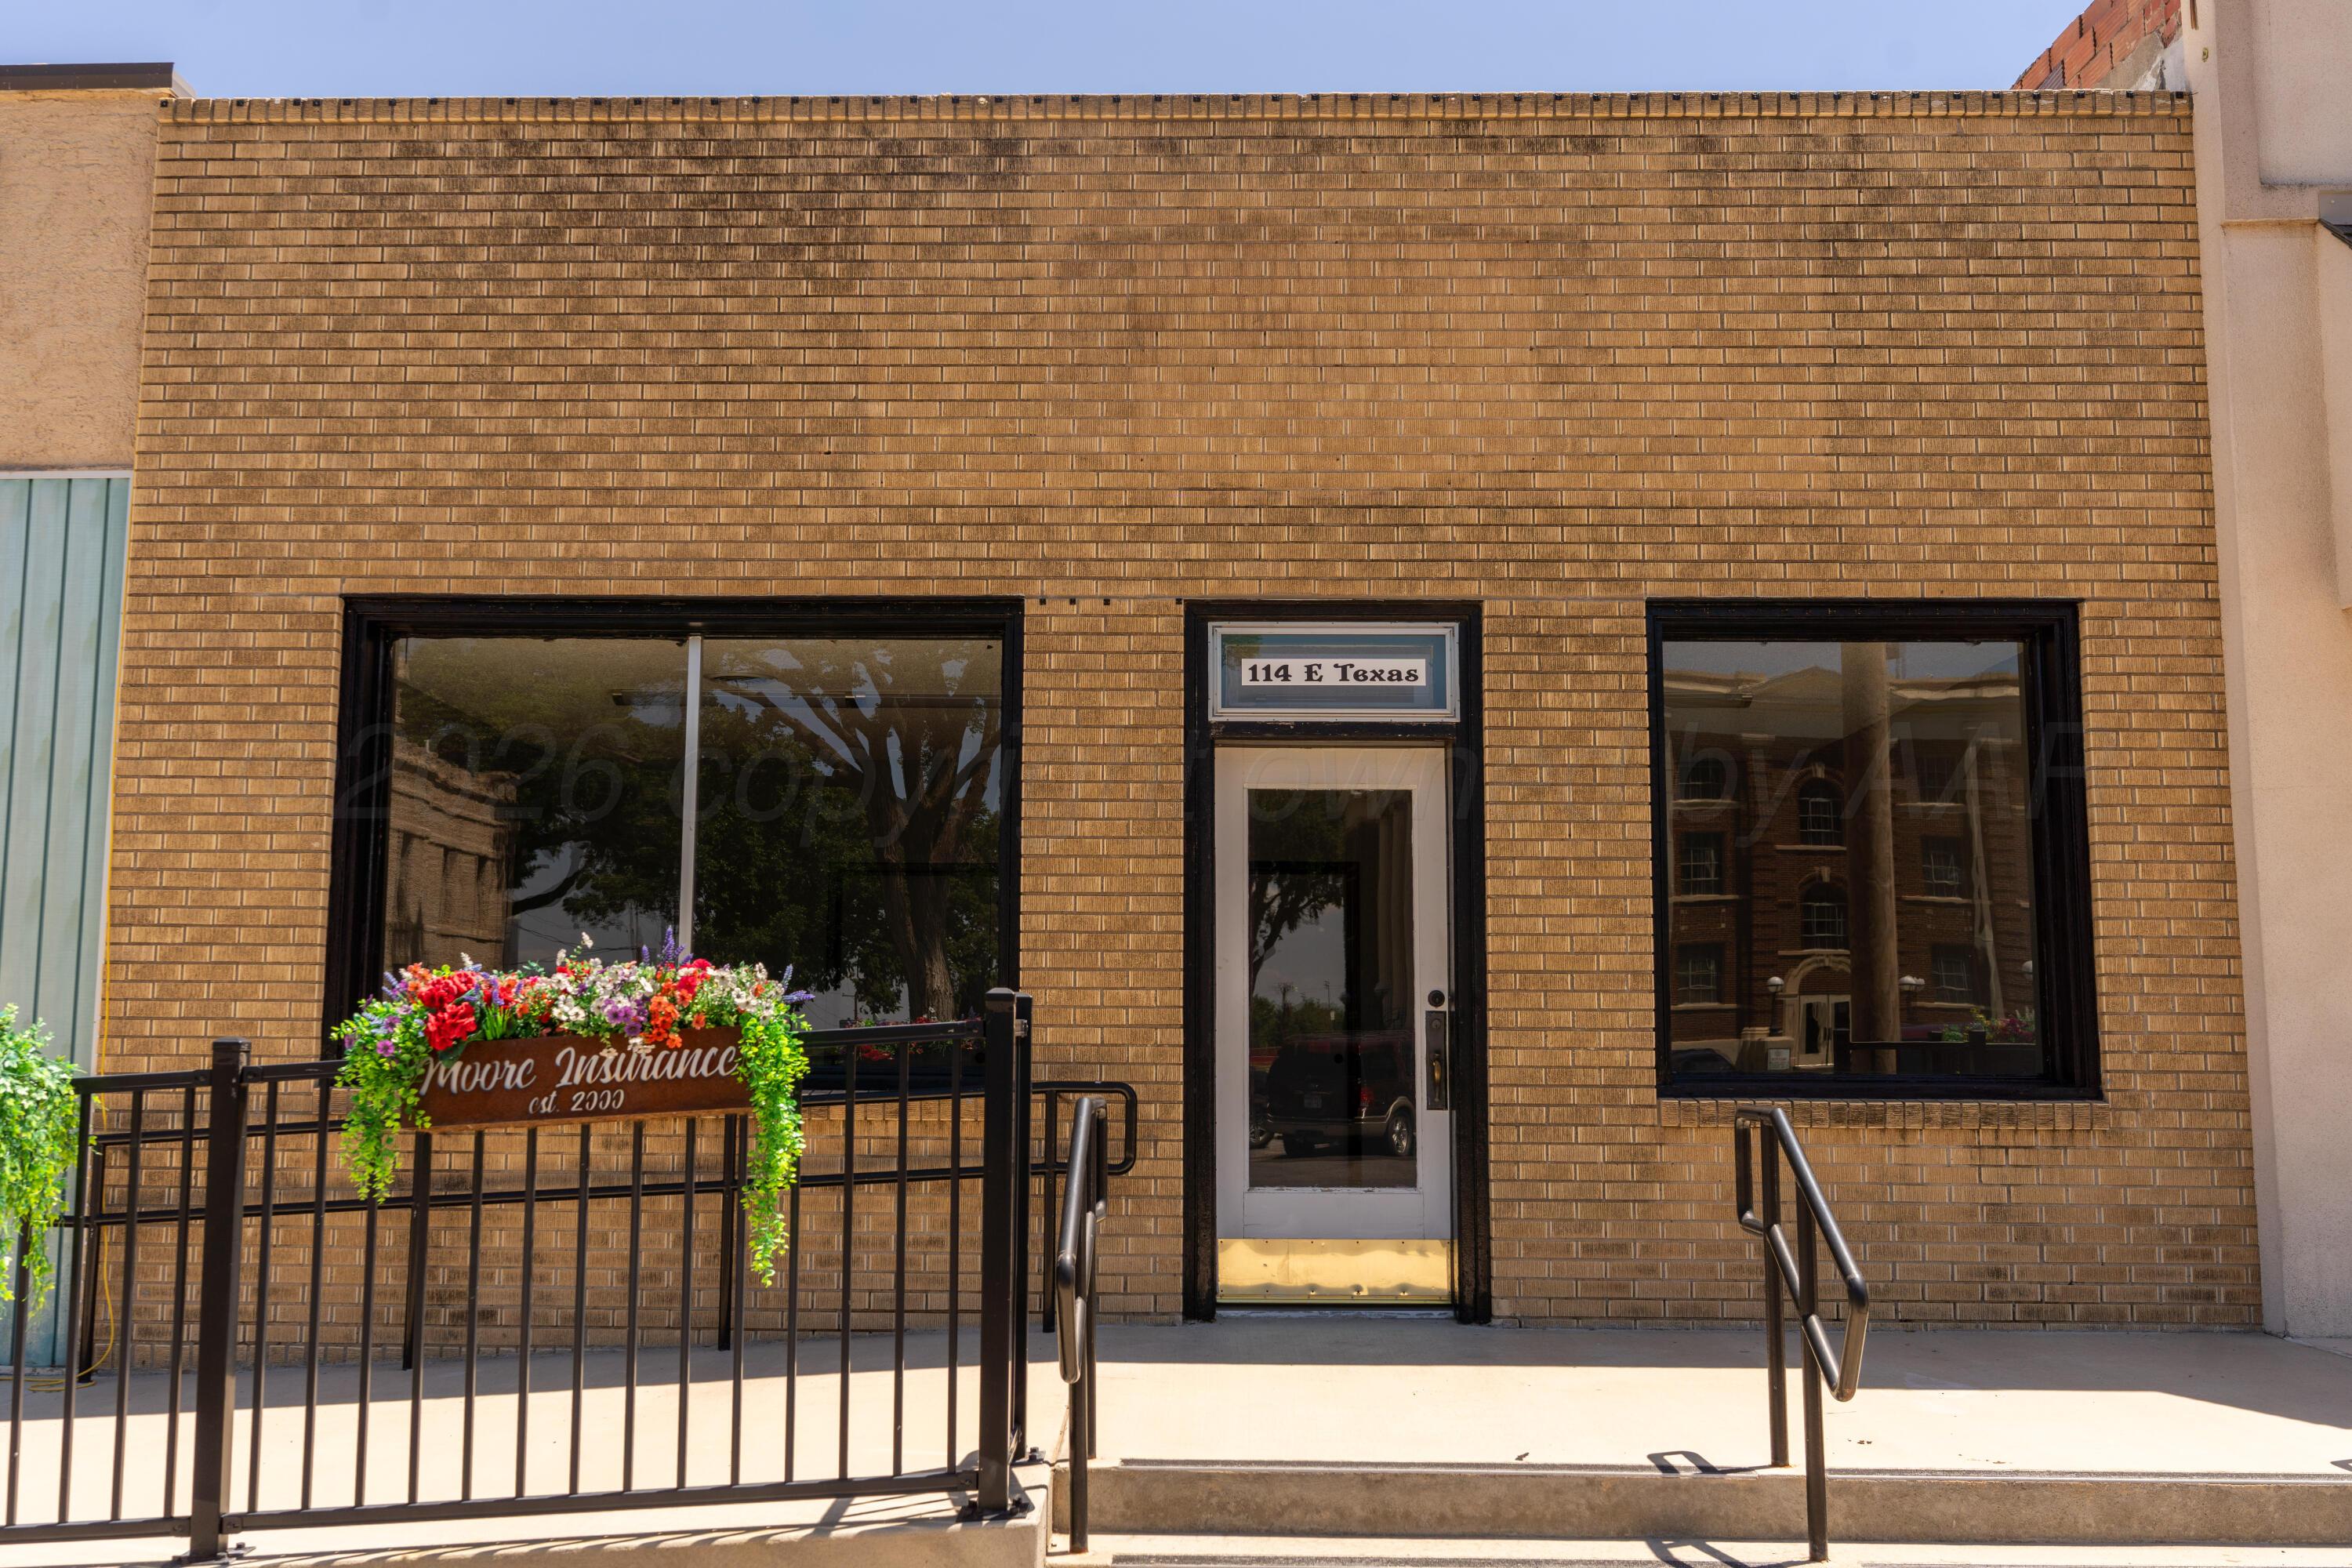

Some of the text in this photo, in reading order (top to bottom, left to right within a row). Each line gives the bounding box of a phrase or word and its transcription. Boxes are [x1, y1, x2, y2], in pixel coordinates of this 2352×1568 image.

[1248, 663, 1419, 682] 114 E Texas
[419, 1045, 739, 1095] Moore Insurance
[528, 1088, 626, 1114] est. 2000
